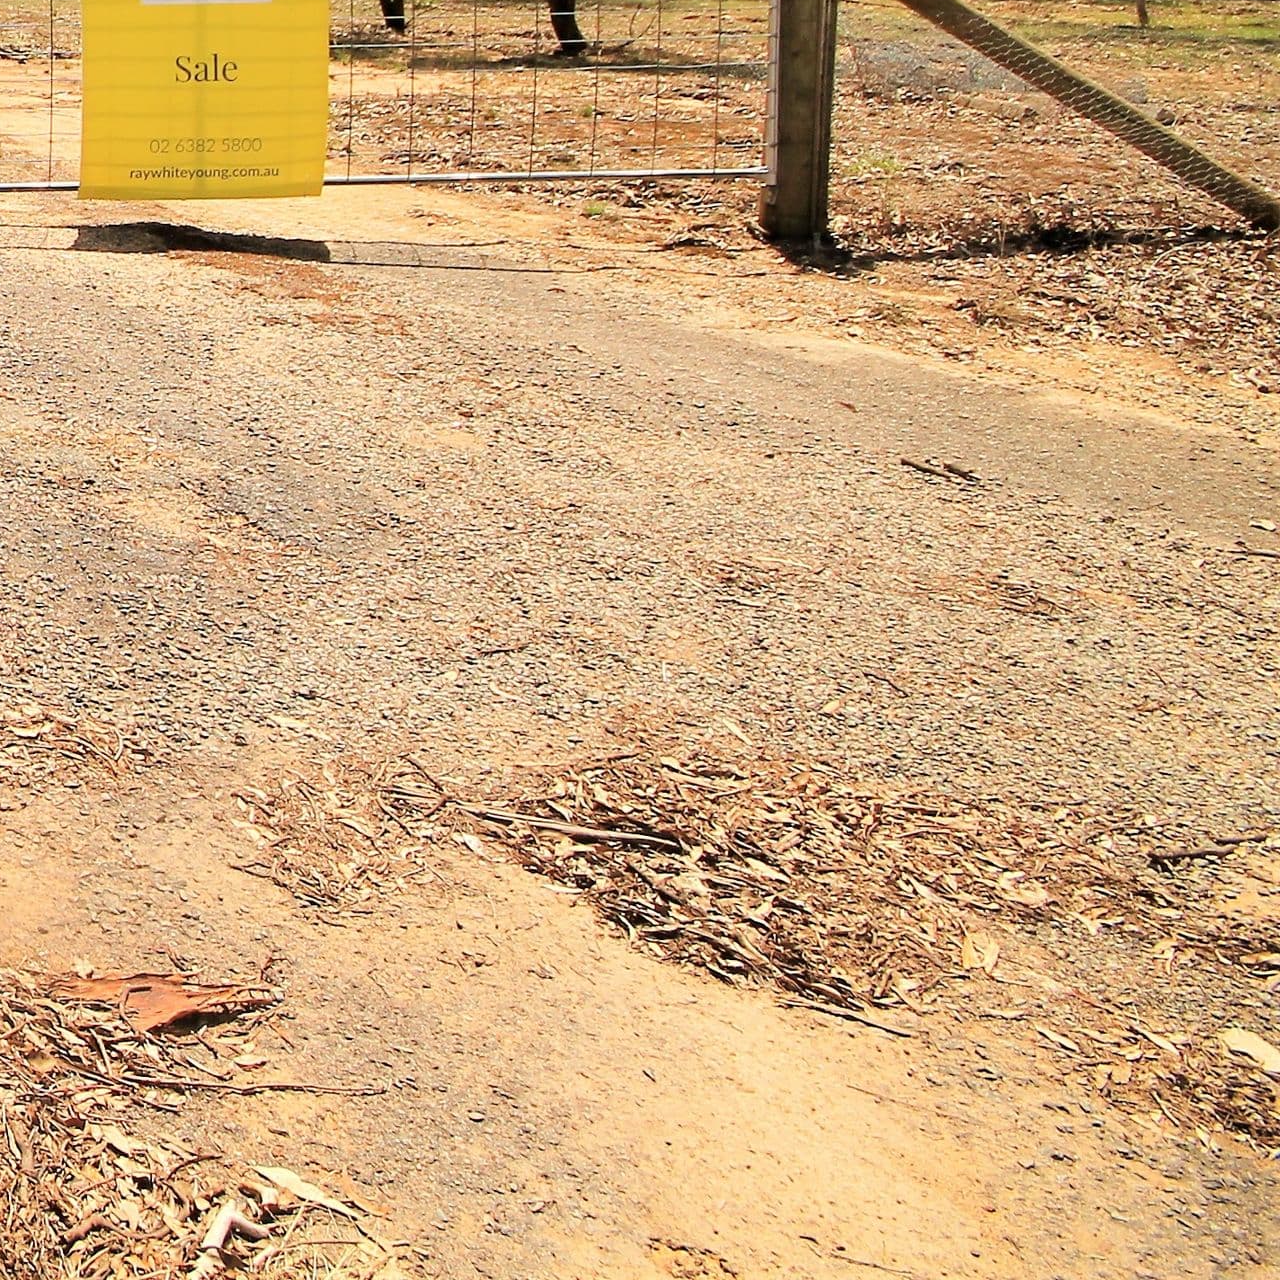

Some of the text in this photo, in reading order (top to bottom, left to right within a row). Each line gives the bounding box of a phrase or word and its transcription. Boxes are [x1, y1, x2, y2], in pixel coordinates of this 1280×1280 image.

[175, 53, 238, 83] Sale
[149, 137, 263, 154] 02 6382 5800
[130, 166, 280, 180] raywhiteyoung.com.au
